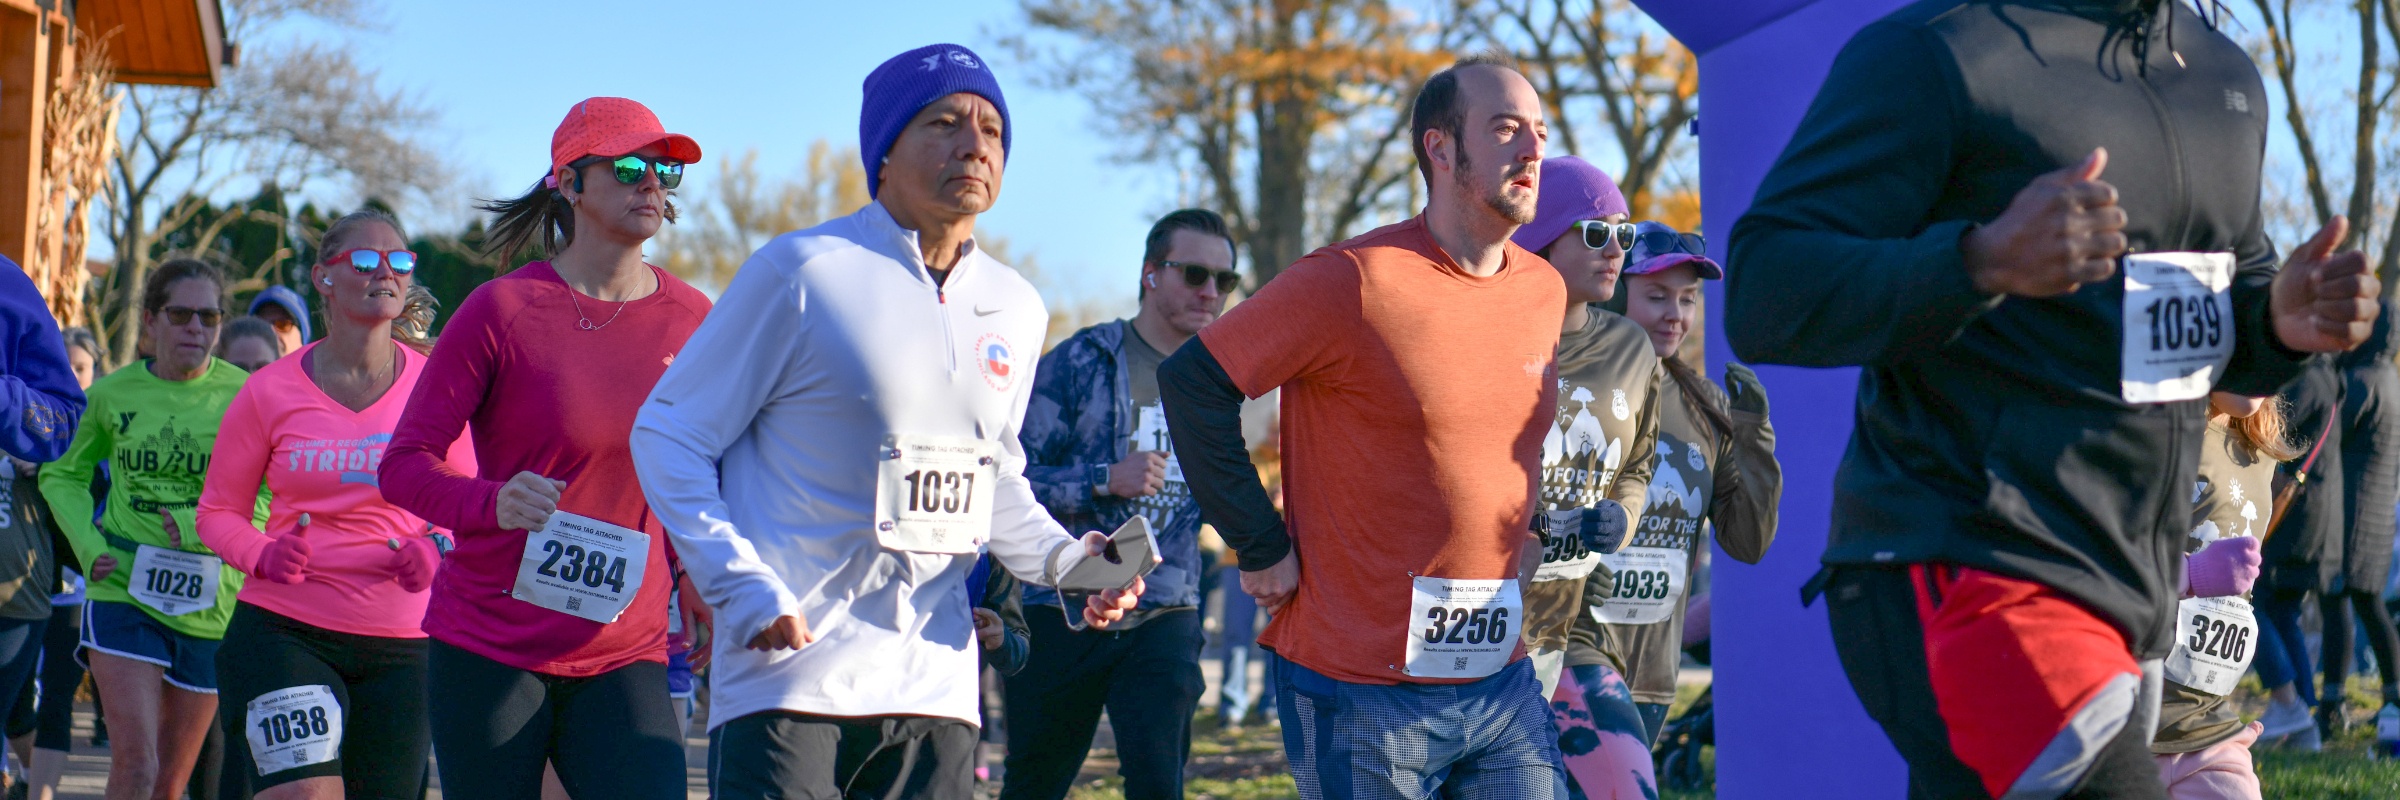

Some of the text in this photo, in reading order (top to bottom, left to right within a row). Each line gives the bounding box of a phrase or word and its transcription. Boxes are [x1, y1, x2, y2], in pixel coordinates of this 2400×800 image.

[2145, 295, 2220, 350] 1039
[118, 448, 158, 472] HUB
[288, 440, 335, 449] CALUMET
[905, 470, 974, 513] 1037
[1554, 467, 1588, 485] FOR
[559, 521, 581, 531] TIMING
[595, 530, 623, 542] ATTACHED
[1639, 515, 1698, 534] FOR THE
[1543, 532, 1590, 563] 393
[537, 539, 627, 594] 2384
[146, 567, 203, 599] 1028
[1442, 585, 1464, 593] TIMING
[1612, 569, 1670, 600] 1933
[1424, 606, 1508, 645] 3256
[2189, 614, 2249, 663] 3206
[258, 705, 329, 747] 1038
